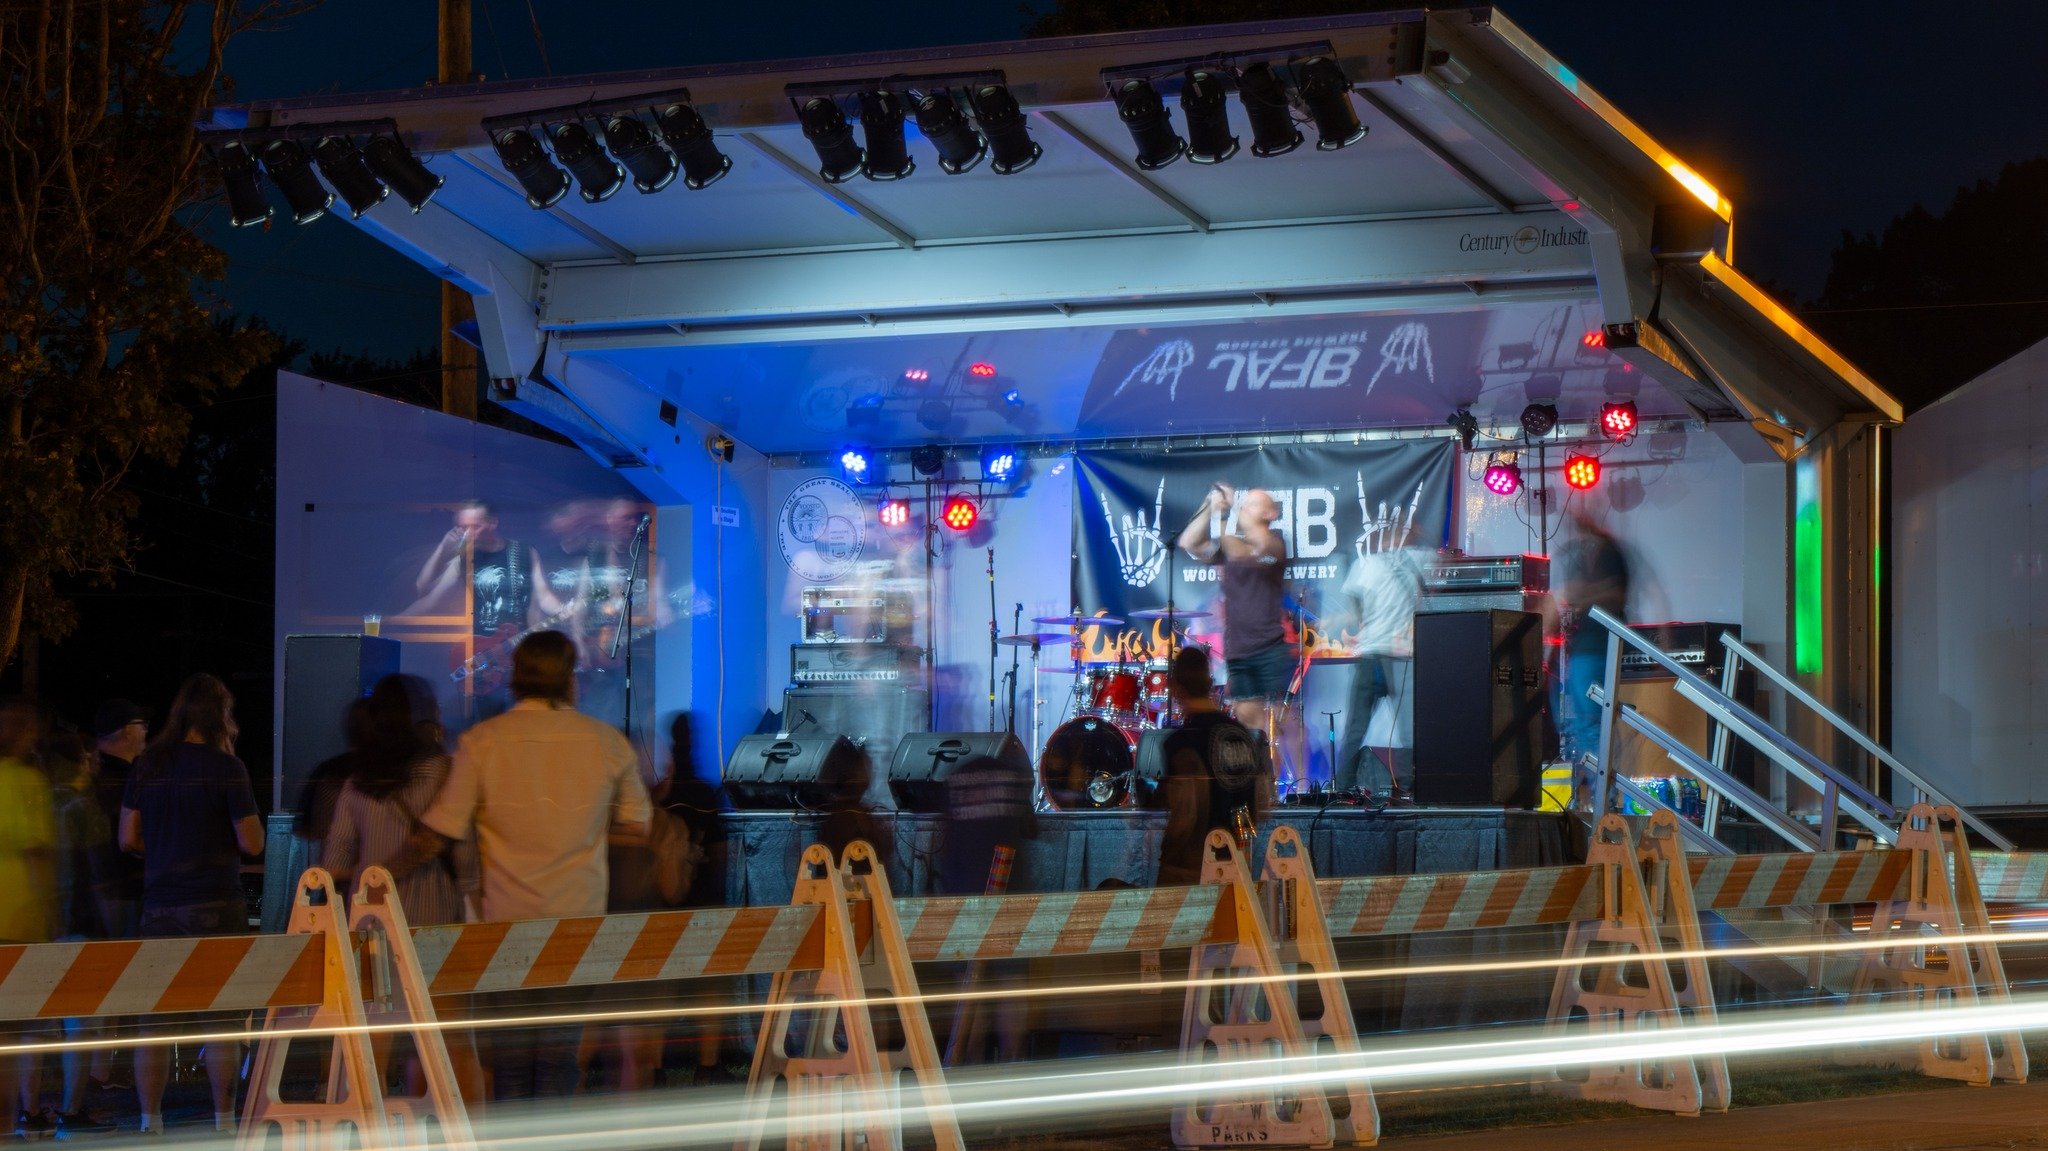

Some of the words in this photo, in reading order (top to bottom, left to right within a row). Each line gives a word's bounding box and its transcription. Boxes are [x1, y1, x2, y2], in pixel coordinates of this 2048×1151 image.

[1459, 233, 1514, 255] Century
[1540, 226, 1591, 248] Industr
[784, 493, 797, 510] THE
[799, 480, 827, 493] GREAT
[829, 481, 851, 495] SEAL
[1282, 565, 1338, 580] EWERY
